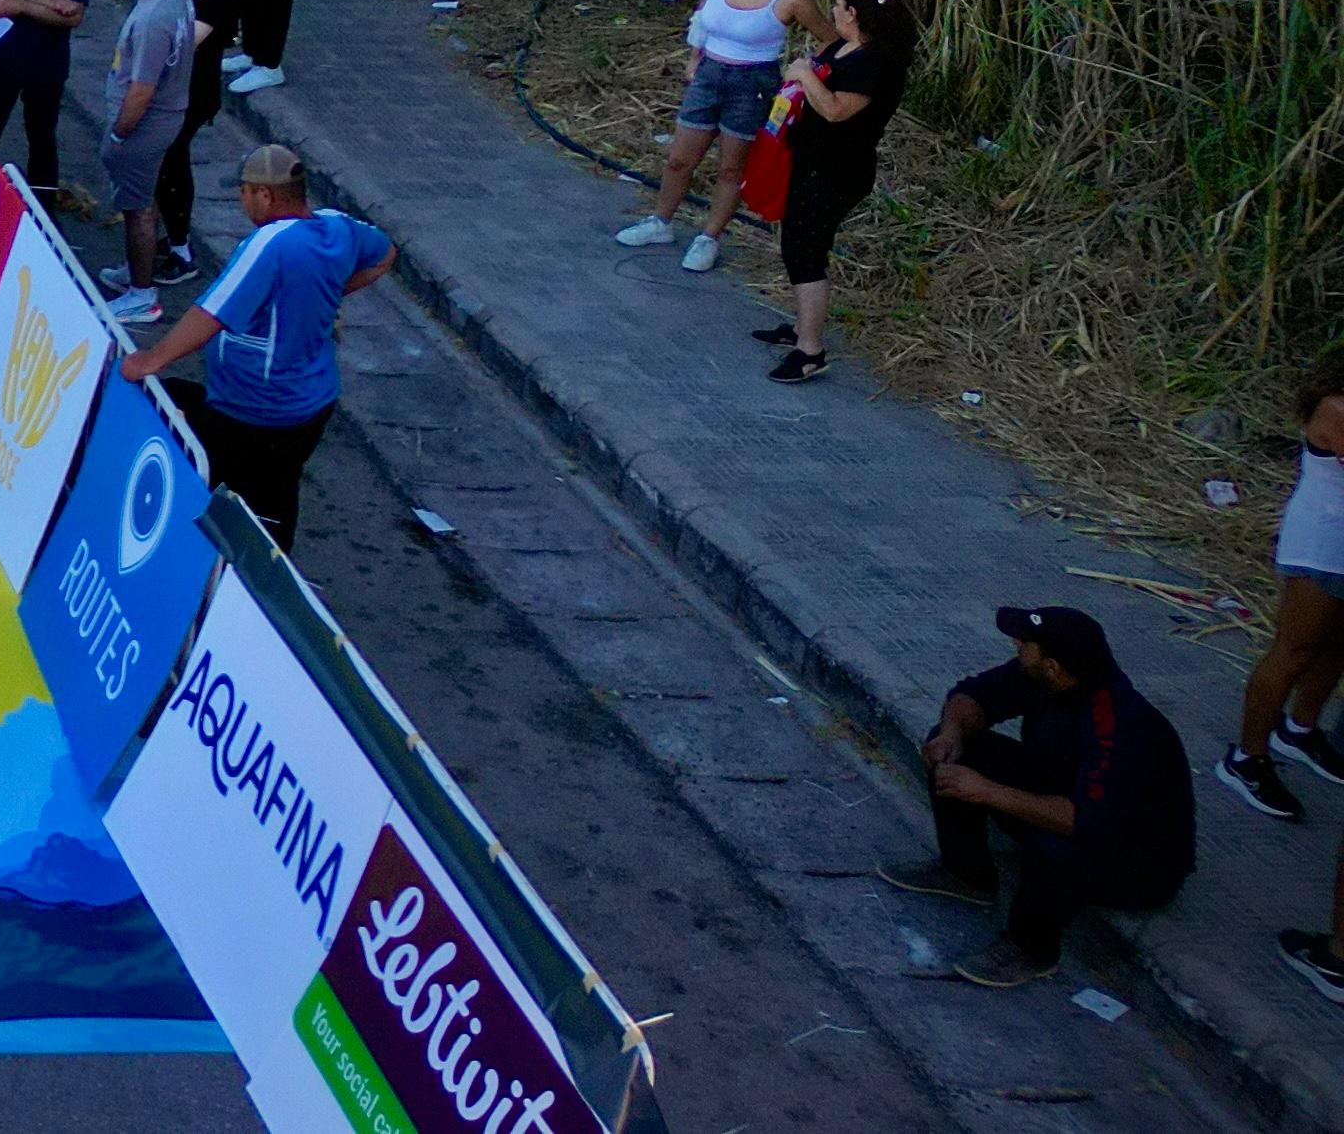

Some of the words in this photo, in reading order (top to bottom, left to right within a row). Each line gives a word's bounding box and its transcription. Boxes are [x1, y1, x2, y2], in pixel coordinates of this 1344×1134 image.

[1, 265, 90, 449] HANG
[58, 538, 141, 701] ROUTES
[170, 649, 345, 939] AQUAFINA
[311, 1001, 343, 1055] Your
[336, 1052, 380, 1118] social
